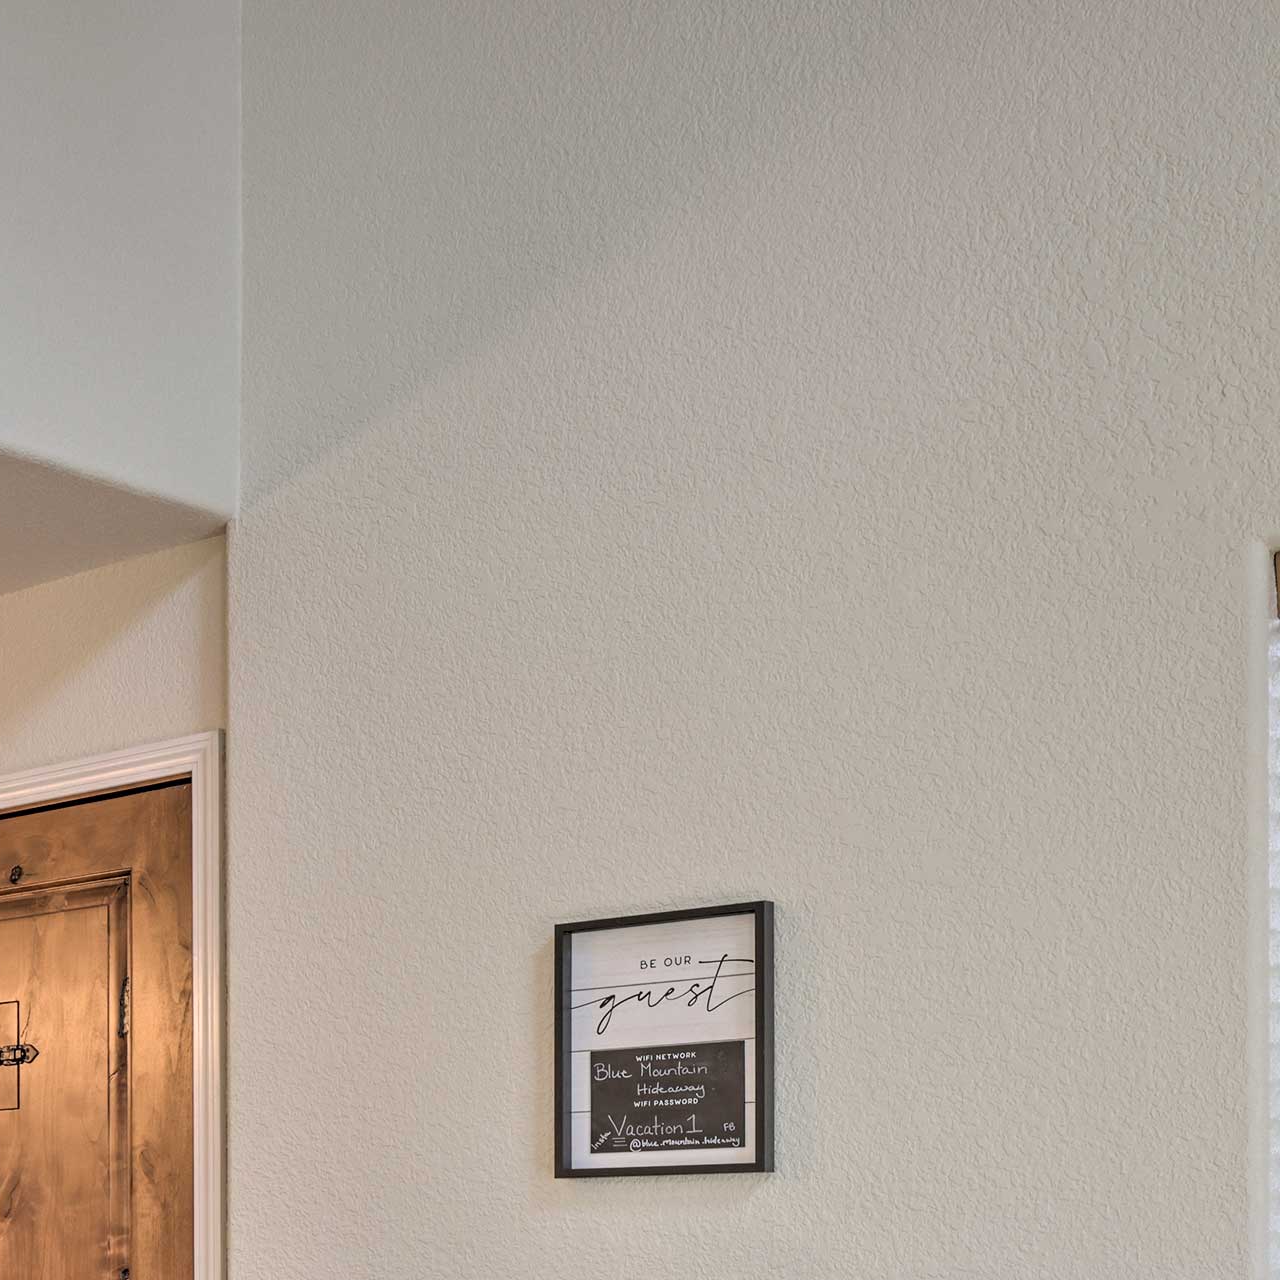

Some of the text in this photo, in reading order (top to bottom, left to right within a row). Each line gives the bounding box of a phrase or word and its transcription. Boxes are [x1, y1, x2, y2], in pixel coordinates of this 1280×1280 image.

[640, 956, 692, 970] BE OUR
[571, 954, 754, 1035] guest
[635, 1051, 696, 1062] WIFI NETWORK
[594, 1061, 708, 1081] Blue Mountain
[637, 1082, 705, 1098] Hideaway
[634, 1097, 699, 1108] WIFI PASSWORD
